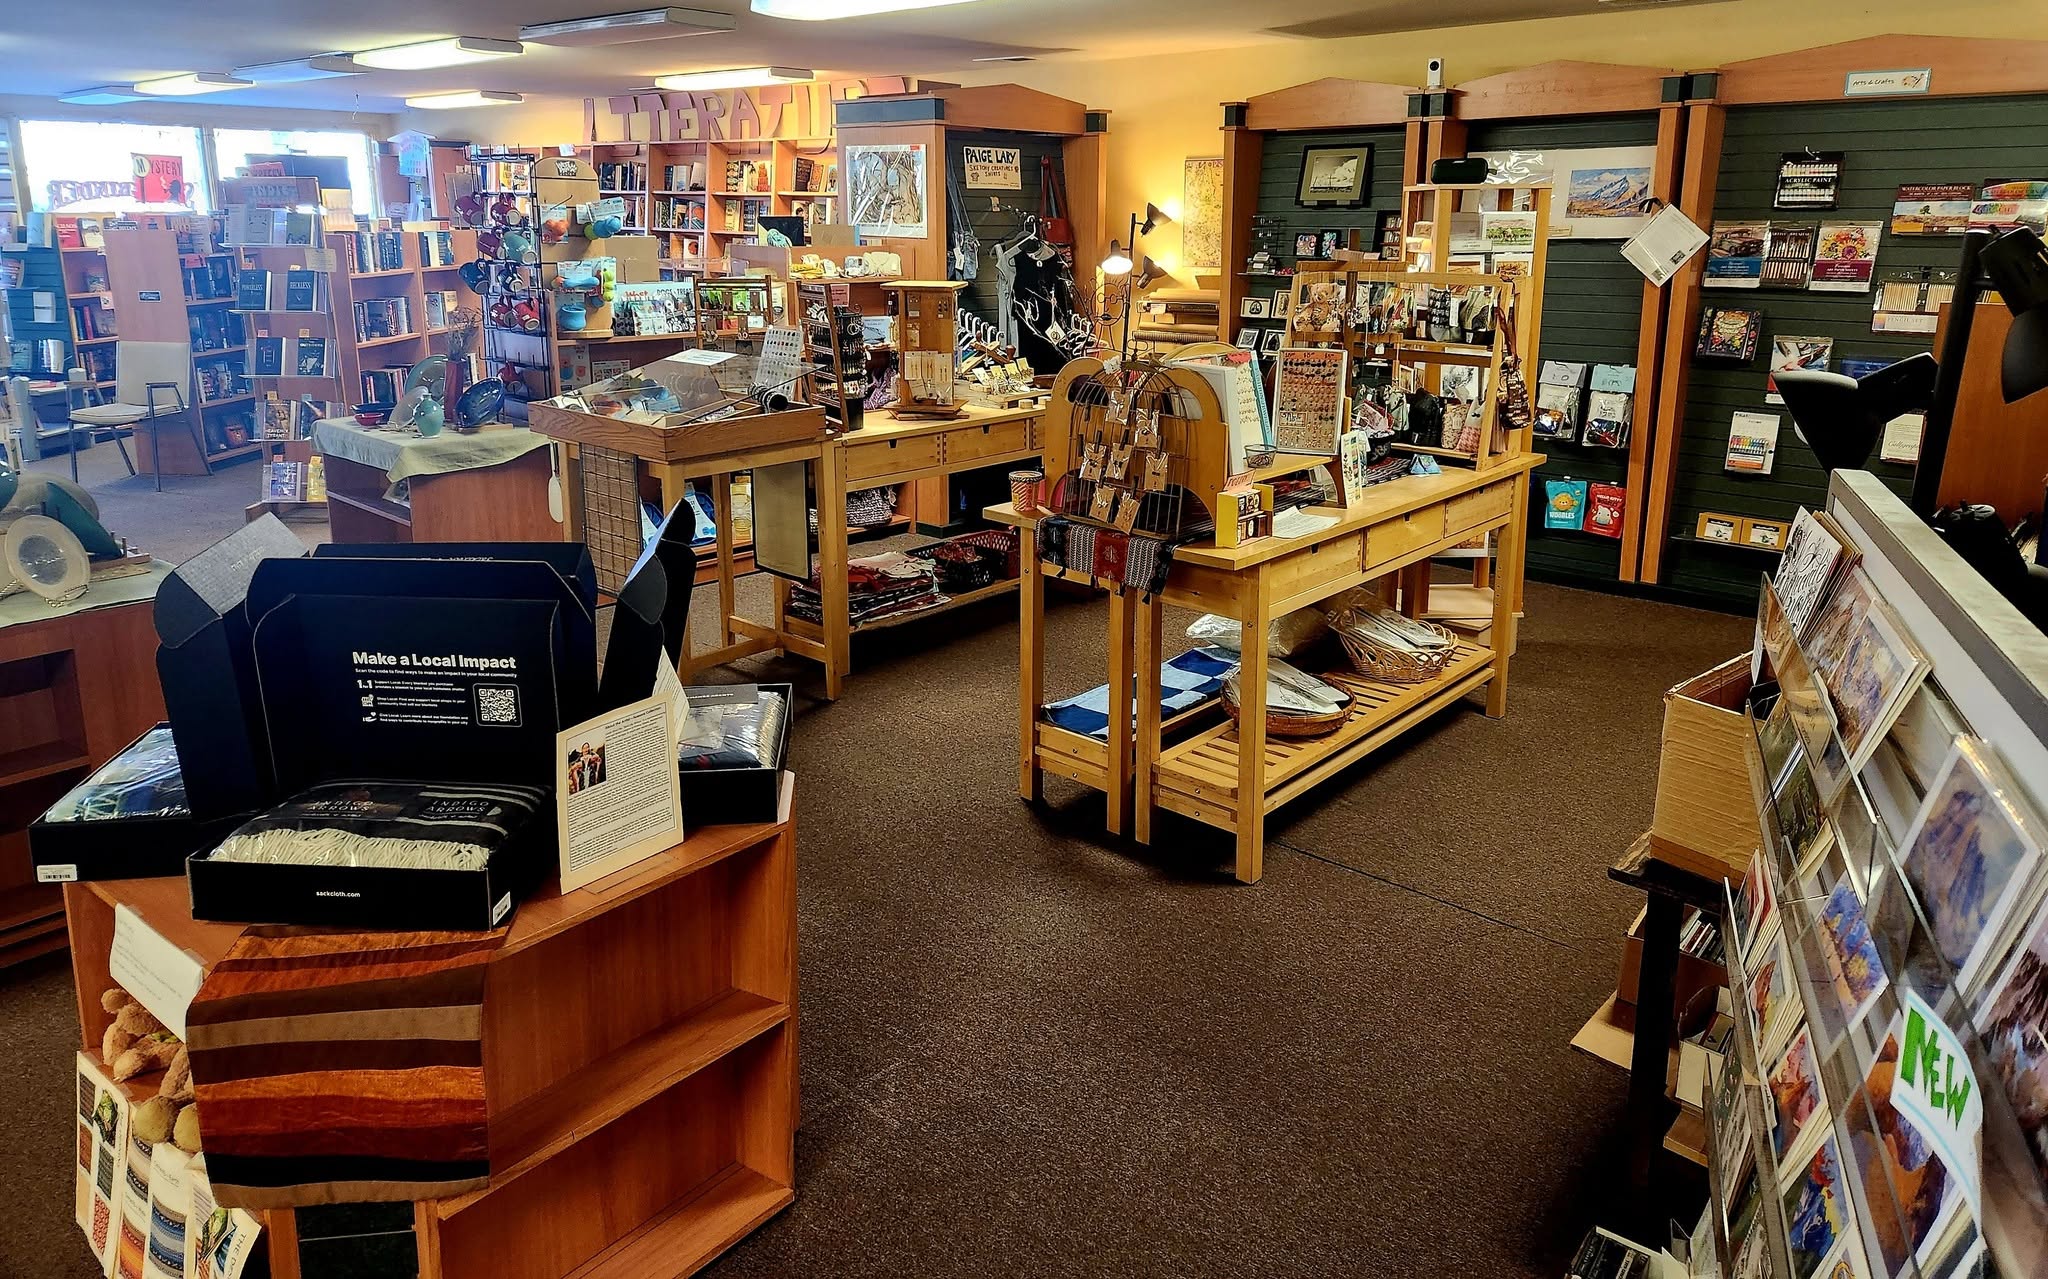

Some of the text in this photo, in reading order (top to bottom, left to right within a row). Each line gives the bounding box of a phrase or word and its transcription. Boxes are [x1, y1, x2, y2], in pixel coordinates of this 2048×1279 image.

[136, 156, 183, 175] MYSTERY
[965, 148, 1016, 164] PAIGE LARY
[352, 652, 516, 670] Make a Local Impact
[1899, 1004, 1972, 1131] NEW
[233, 1232, 248, 1252] THE
